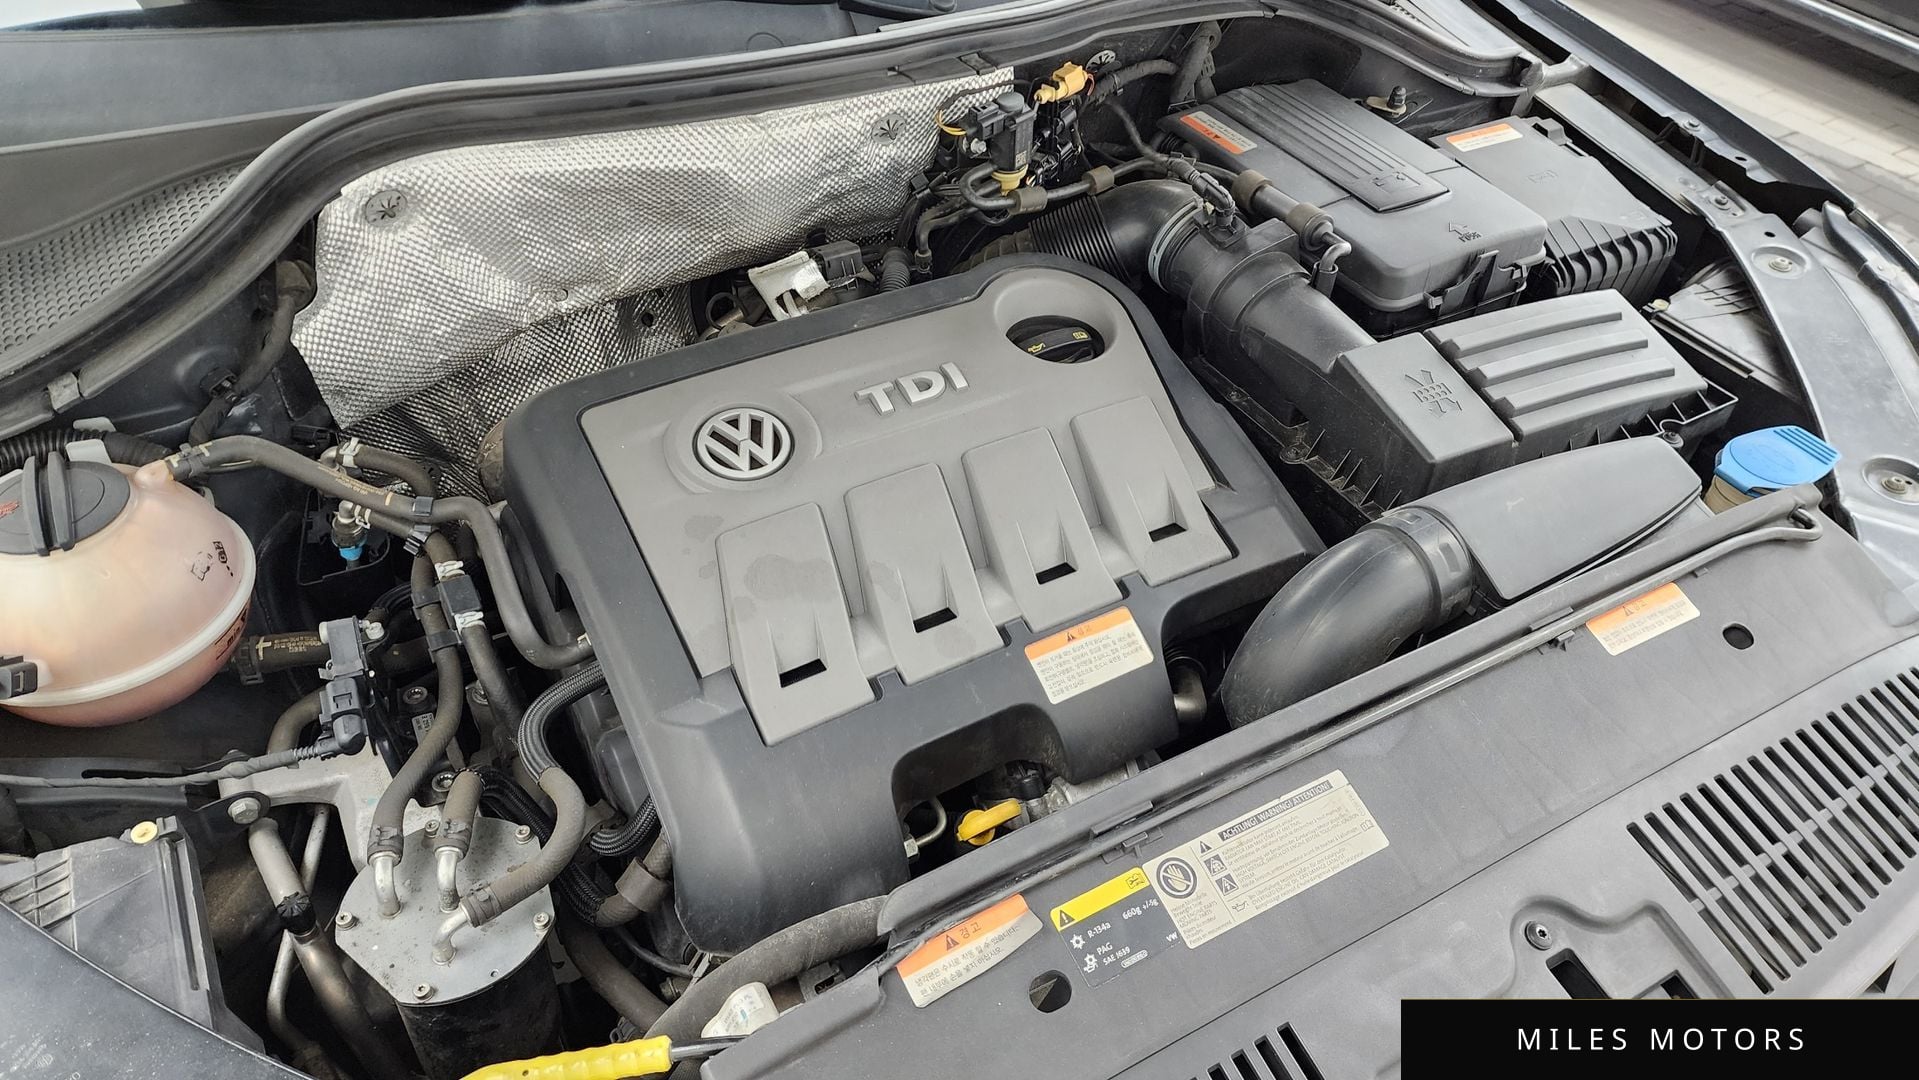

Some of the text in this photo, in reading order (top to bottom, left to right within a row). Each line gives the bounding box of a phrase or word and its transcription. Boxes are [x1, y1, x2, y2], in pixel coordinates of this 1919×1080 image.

[854, 361, 970, 416] TDI
[692, 407, 796, 481] VW
[1222, 817, 1259, 839] ACHTUNG!
[1258, 800, 1294, 822] WARNING!
[1293, 782, 1330, 805] ATTENTION!
[1087, 921, 1111, 938] R-134a
[1122, 906, 1142, 920] 660g
[1166, 931, 1179, 942] VW
[1097, 942, 1113, 955] PAG
[1102, 953, 1117, 966] SAE
[1115, 946, 1131, 960] J639
